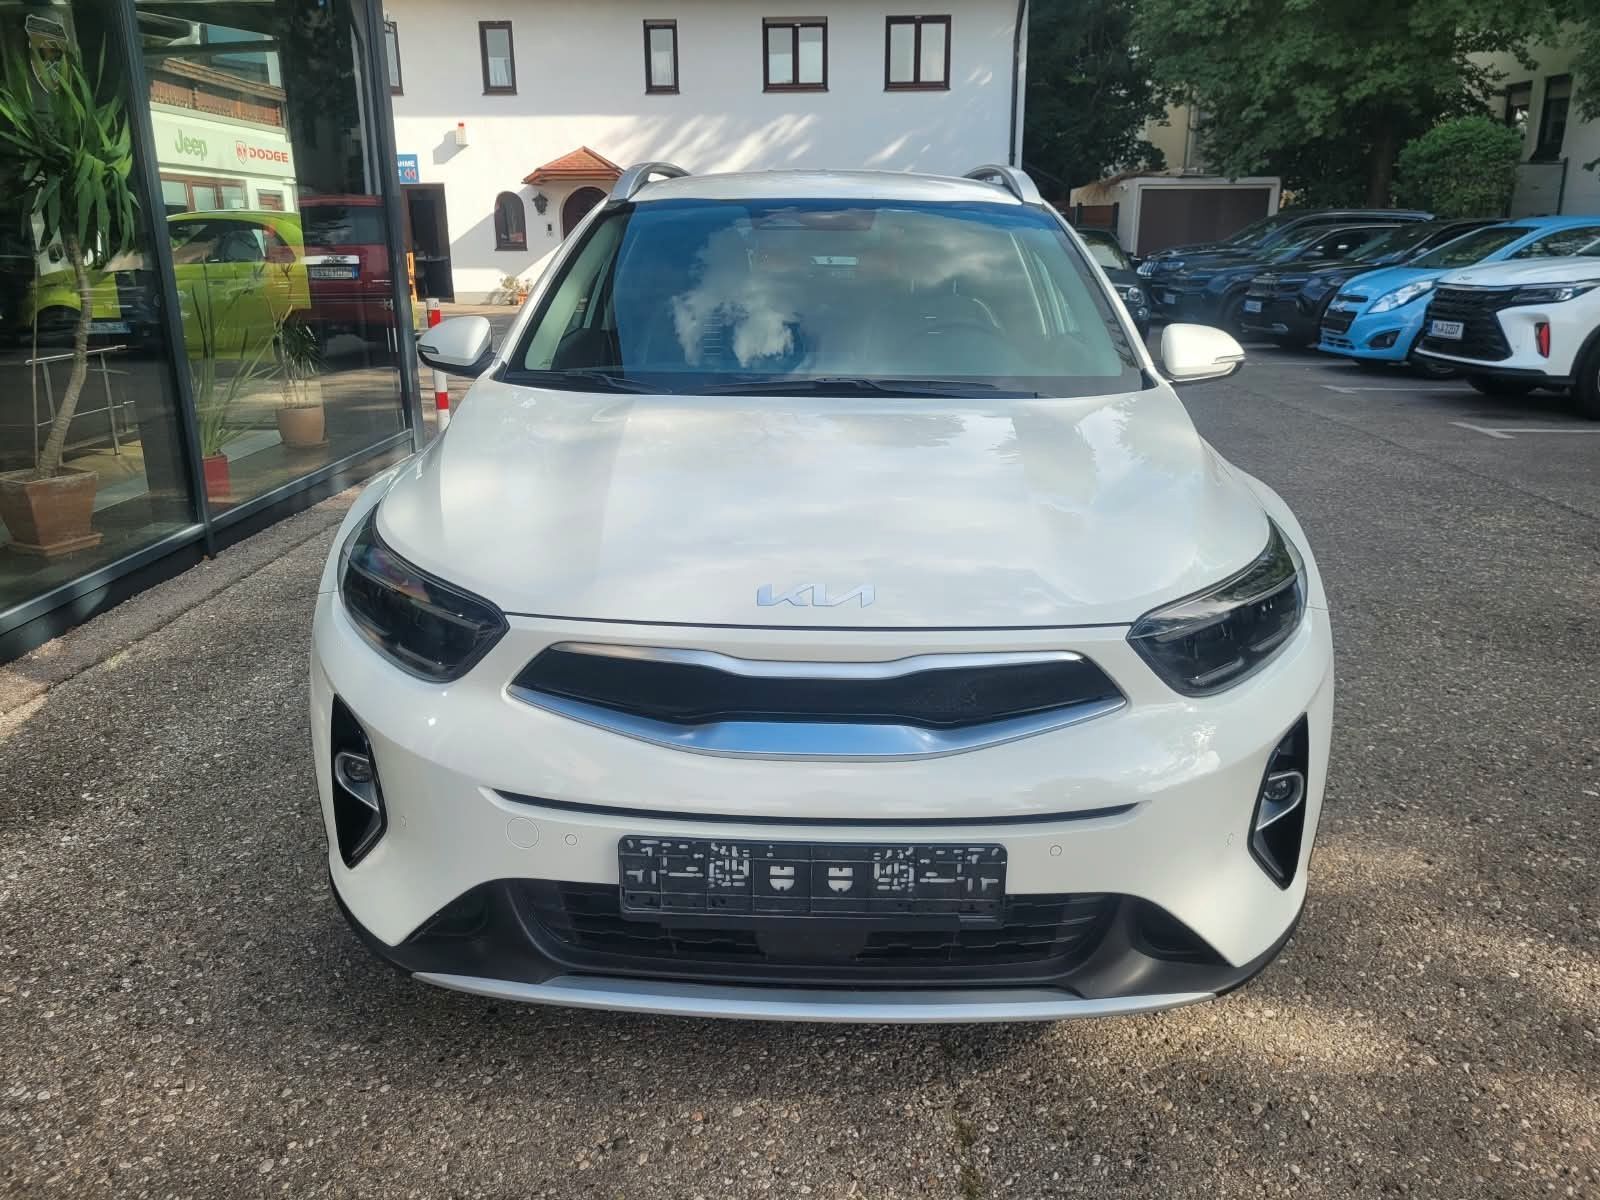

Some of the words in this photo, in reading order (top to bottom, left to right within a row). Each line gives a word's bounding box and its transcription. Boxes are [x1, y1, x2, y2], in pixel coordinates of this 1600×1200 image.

[175, 128, 207, 161] Jeep
[249, 147, 289, 163] DODGE
[756, 583, 876, 608] KIA
